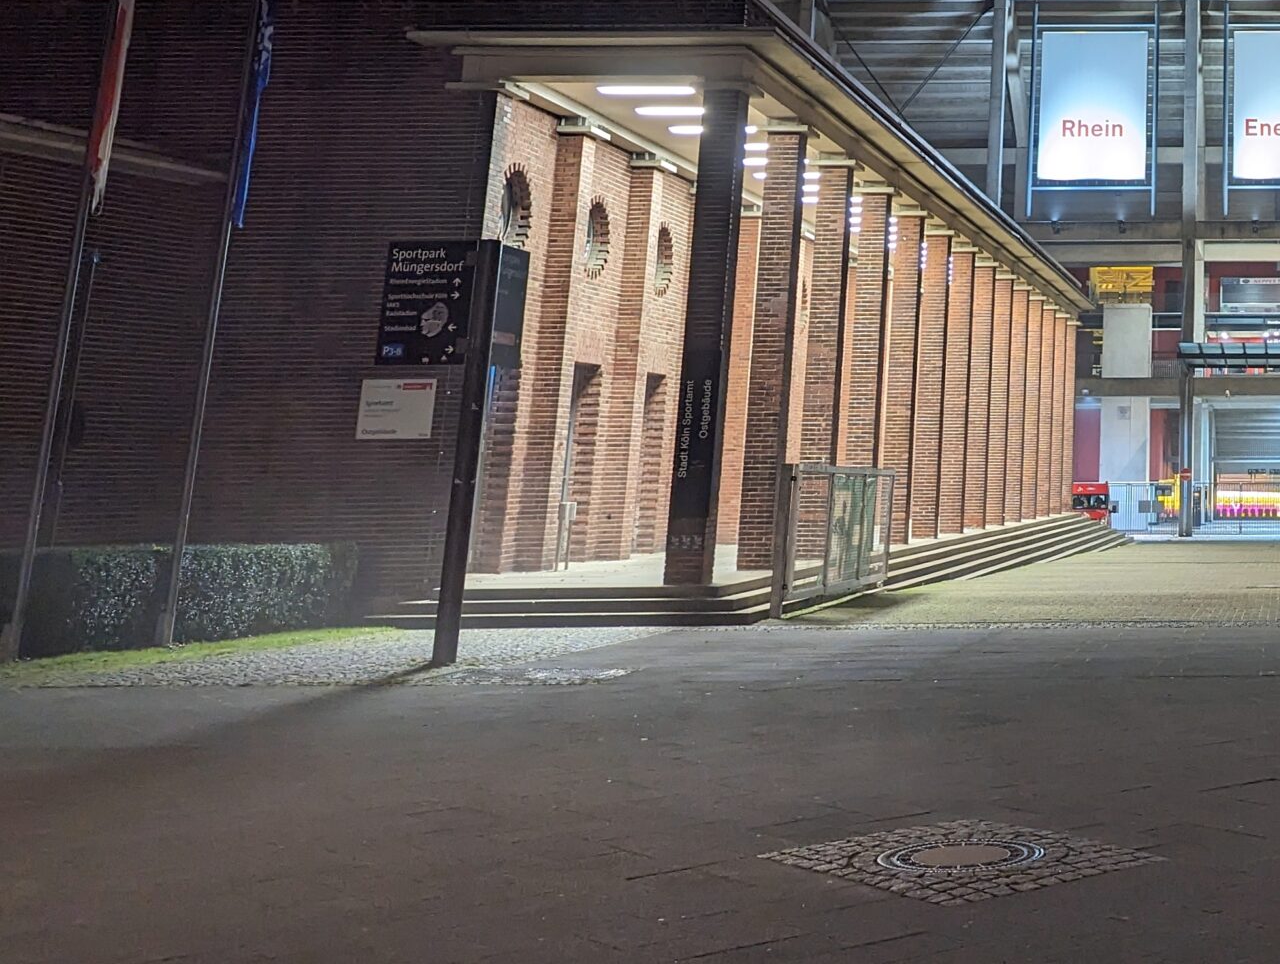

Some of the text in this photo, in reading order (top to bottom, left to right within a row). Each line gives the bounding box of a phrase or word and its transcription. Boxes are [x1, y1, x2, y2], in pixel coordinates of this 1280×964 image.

[1061, 119, 1124, 138] Rhein
[392, 248, 447, 261] Sportpark
[391, 260, 465, 275] Müngersdorf
[699, 379, 712, 439] Ostgebäude
[678, 380, 695, 478] Stadt Köln Sportamt
